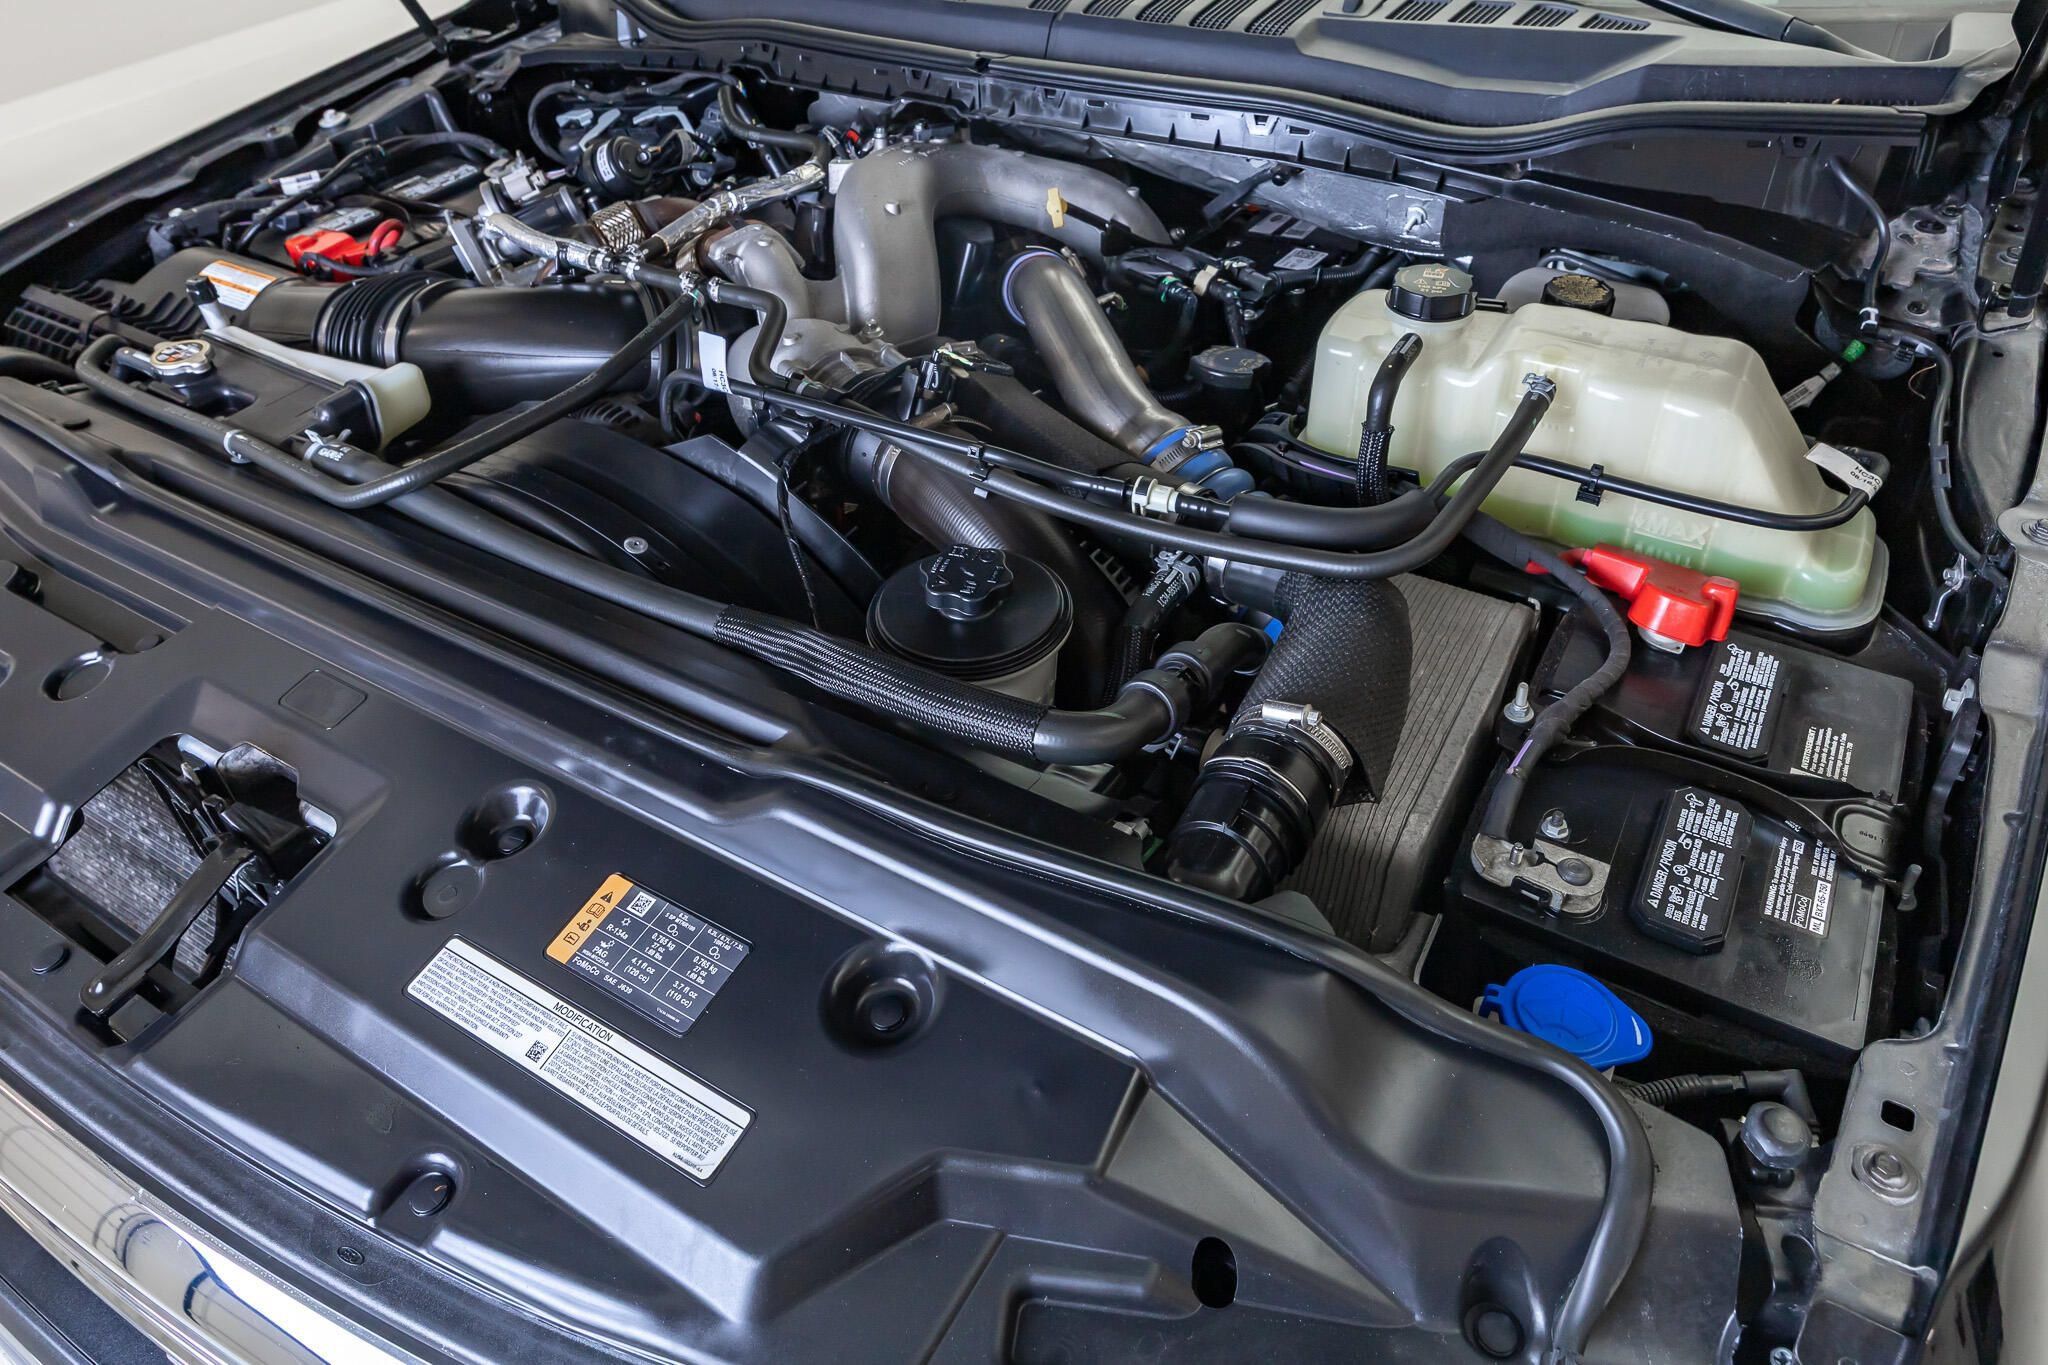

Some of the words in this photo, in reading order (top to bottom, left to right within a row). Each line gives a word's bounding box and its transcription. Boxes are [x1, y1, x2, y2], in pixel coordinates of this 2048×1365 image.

[1801, 729, 1815, 768] AVERTISSEMENT
[1780, 837, 1788, 849] injury
[1777, 848, 1785, 867] personal
[1764, 884, 1777, 915] WARNING:
[1794, 896, 1807, 926] FoMoCo
[606, 924, 628, 939] R-134a
[652, 932, 669, 945] 0.765
[667, 941, 675, 950] kg
[592, 946, 608, 958] PAG
[624, 965, 639, 976] (120
[638, 974, 650, 984] cc)
[631, 957, 642, 966] 4.1
[646, 966, 655, 974] oz
[693, 956, 711, 968] 0.765
[708, 964, 718, 974] kg
[572, 956, 600, 975] FoMoCo
[604, 974, 617, 985] SAE
[618, 984, 632, 994] J639
[672, 980, 685, 990] 3.7
[682, 986, 690, 994] fl
[666, 989, 682, 1001] (110
[680, 998, 692, 1008] cc)
[554, 1002, 612, 1041] MODIFICATION
